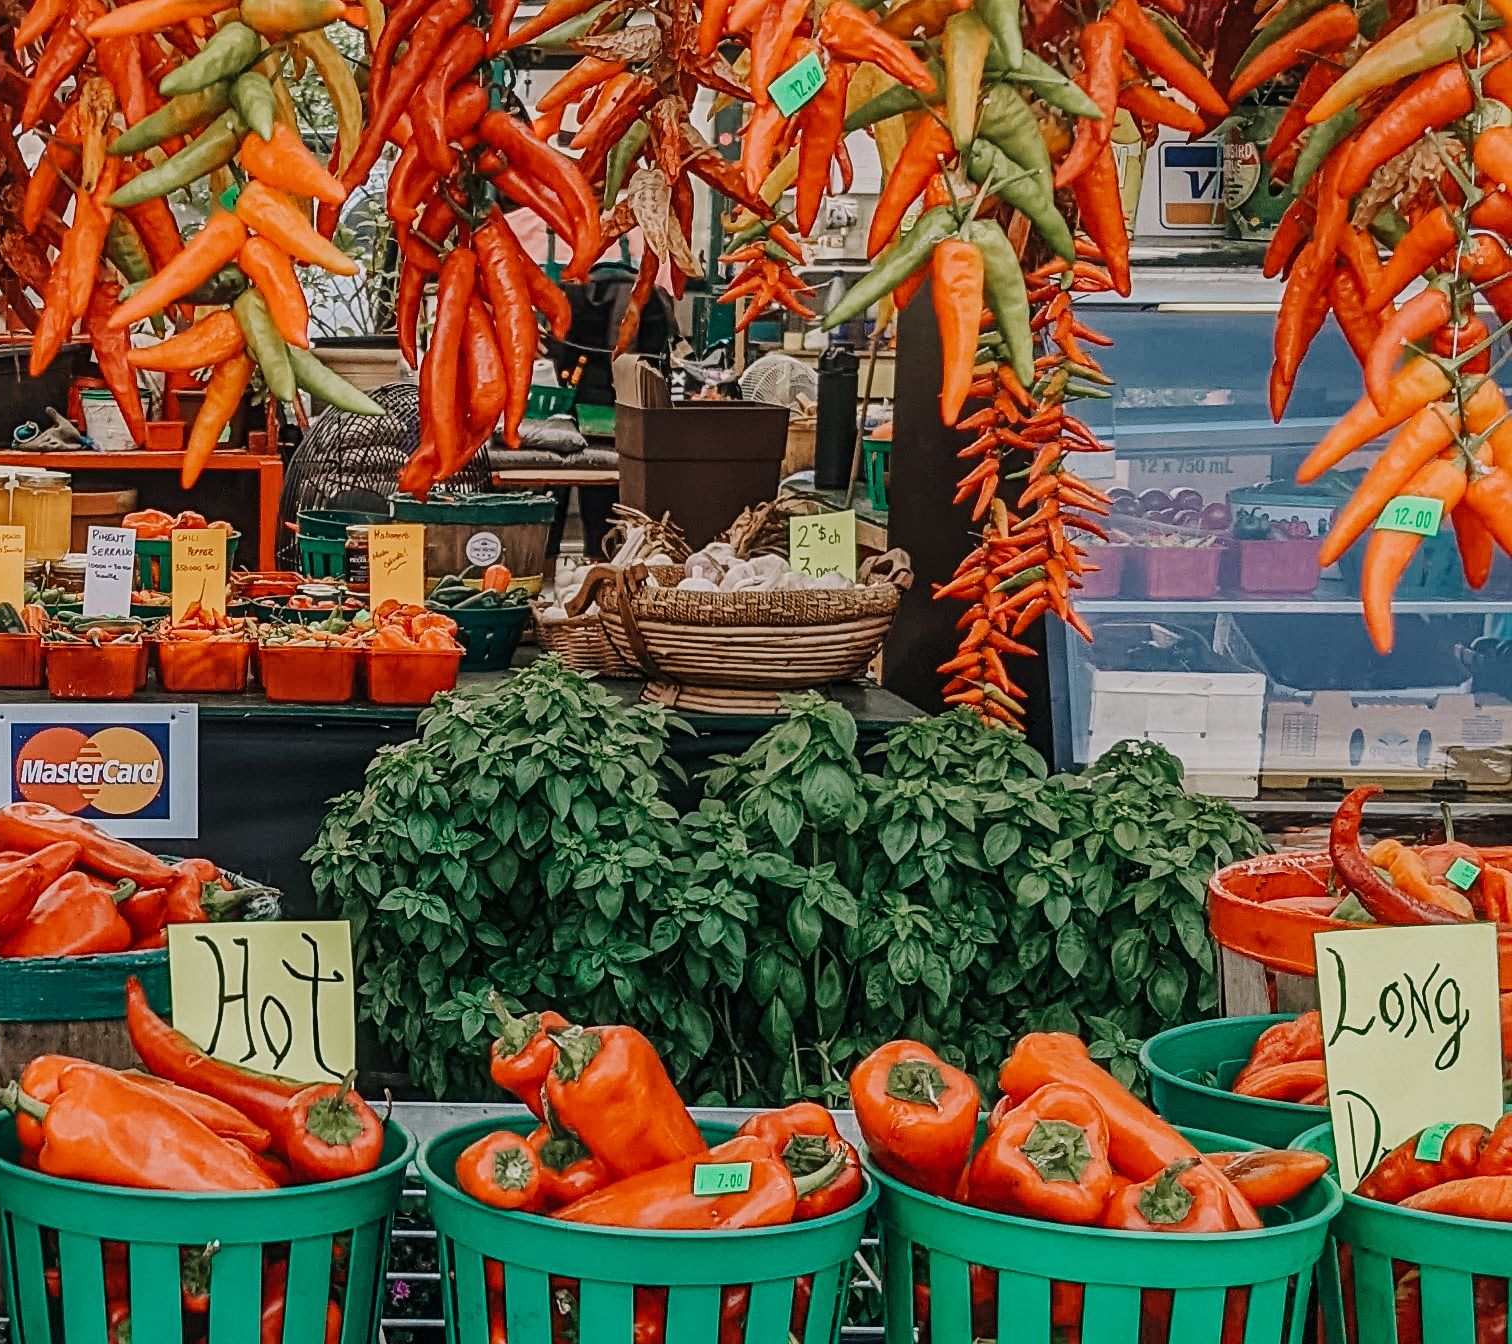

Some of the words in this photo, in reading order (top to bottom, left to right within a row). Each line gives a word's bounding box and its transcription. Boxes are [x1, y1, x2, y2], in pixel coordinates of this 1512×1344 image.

[789, 65, 821, 99] 12.00
[1393, 507, 1433, 529] 12.00
[91, 545, 133, 557] SERRANO
[19, 758, 161, 787] MasterCard
[716, 1172, 744, 1189] 7.00
